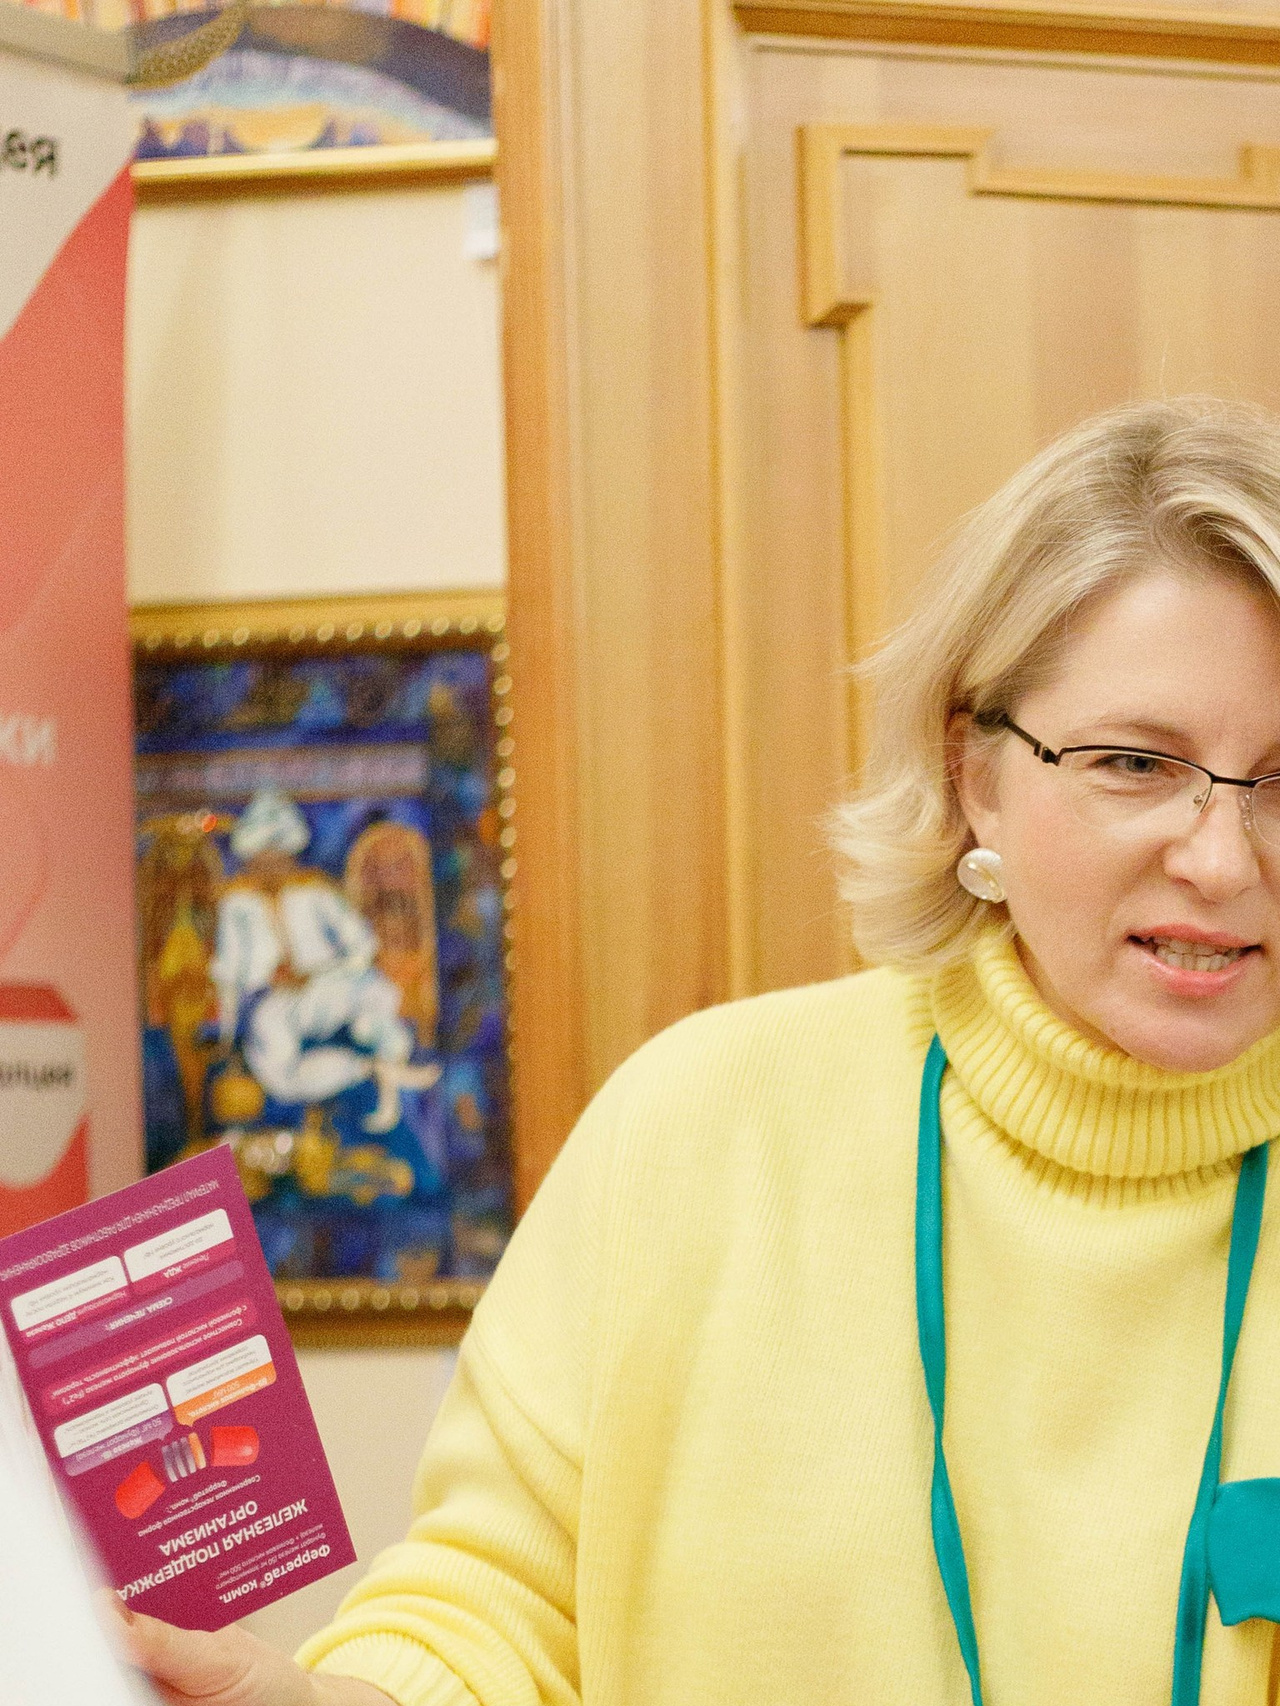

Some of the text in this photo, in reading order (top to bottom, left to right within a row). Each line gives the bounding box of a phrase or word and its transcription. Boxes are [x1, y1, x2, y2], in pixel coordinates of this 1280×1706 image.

[115, 1497, 308, 1603] ЖЕЛЕЗНАЯ ПОДДЕРЖКА
[158, 1498, 259, 1558] ОРГАНИЗМА
[218, 1578, 258, 1605] комп.
